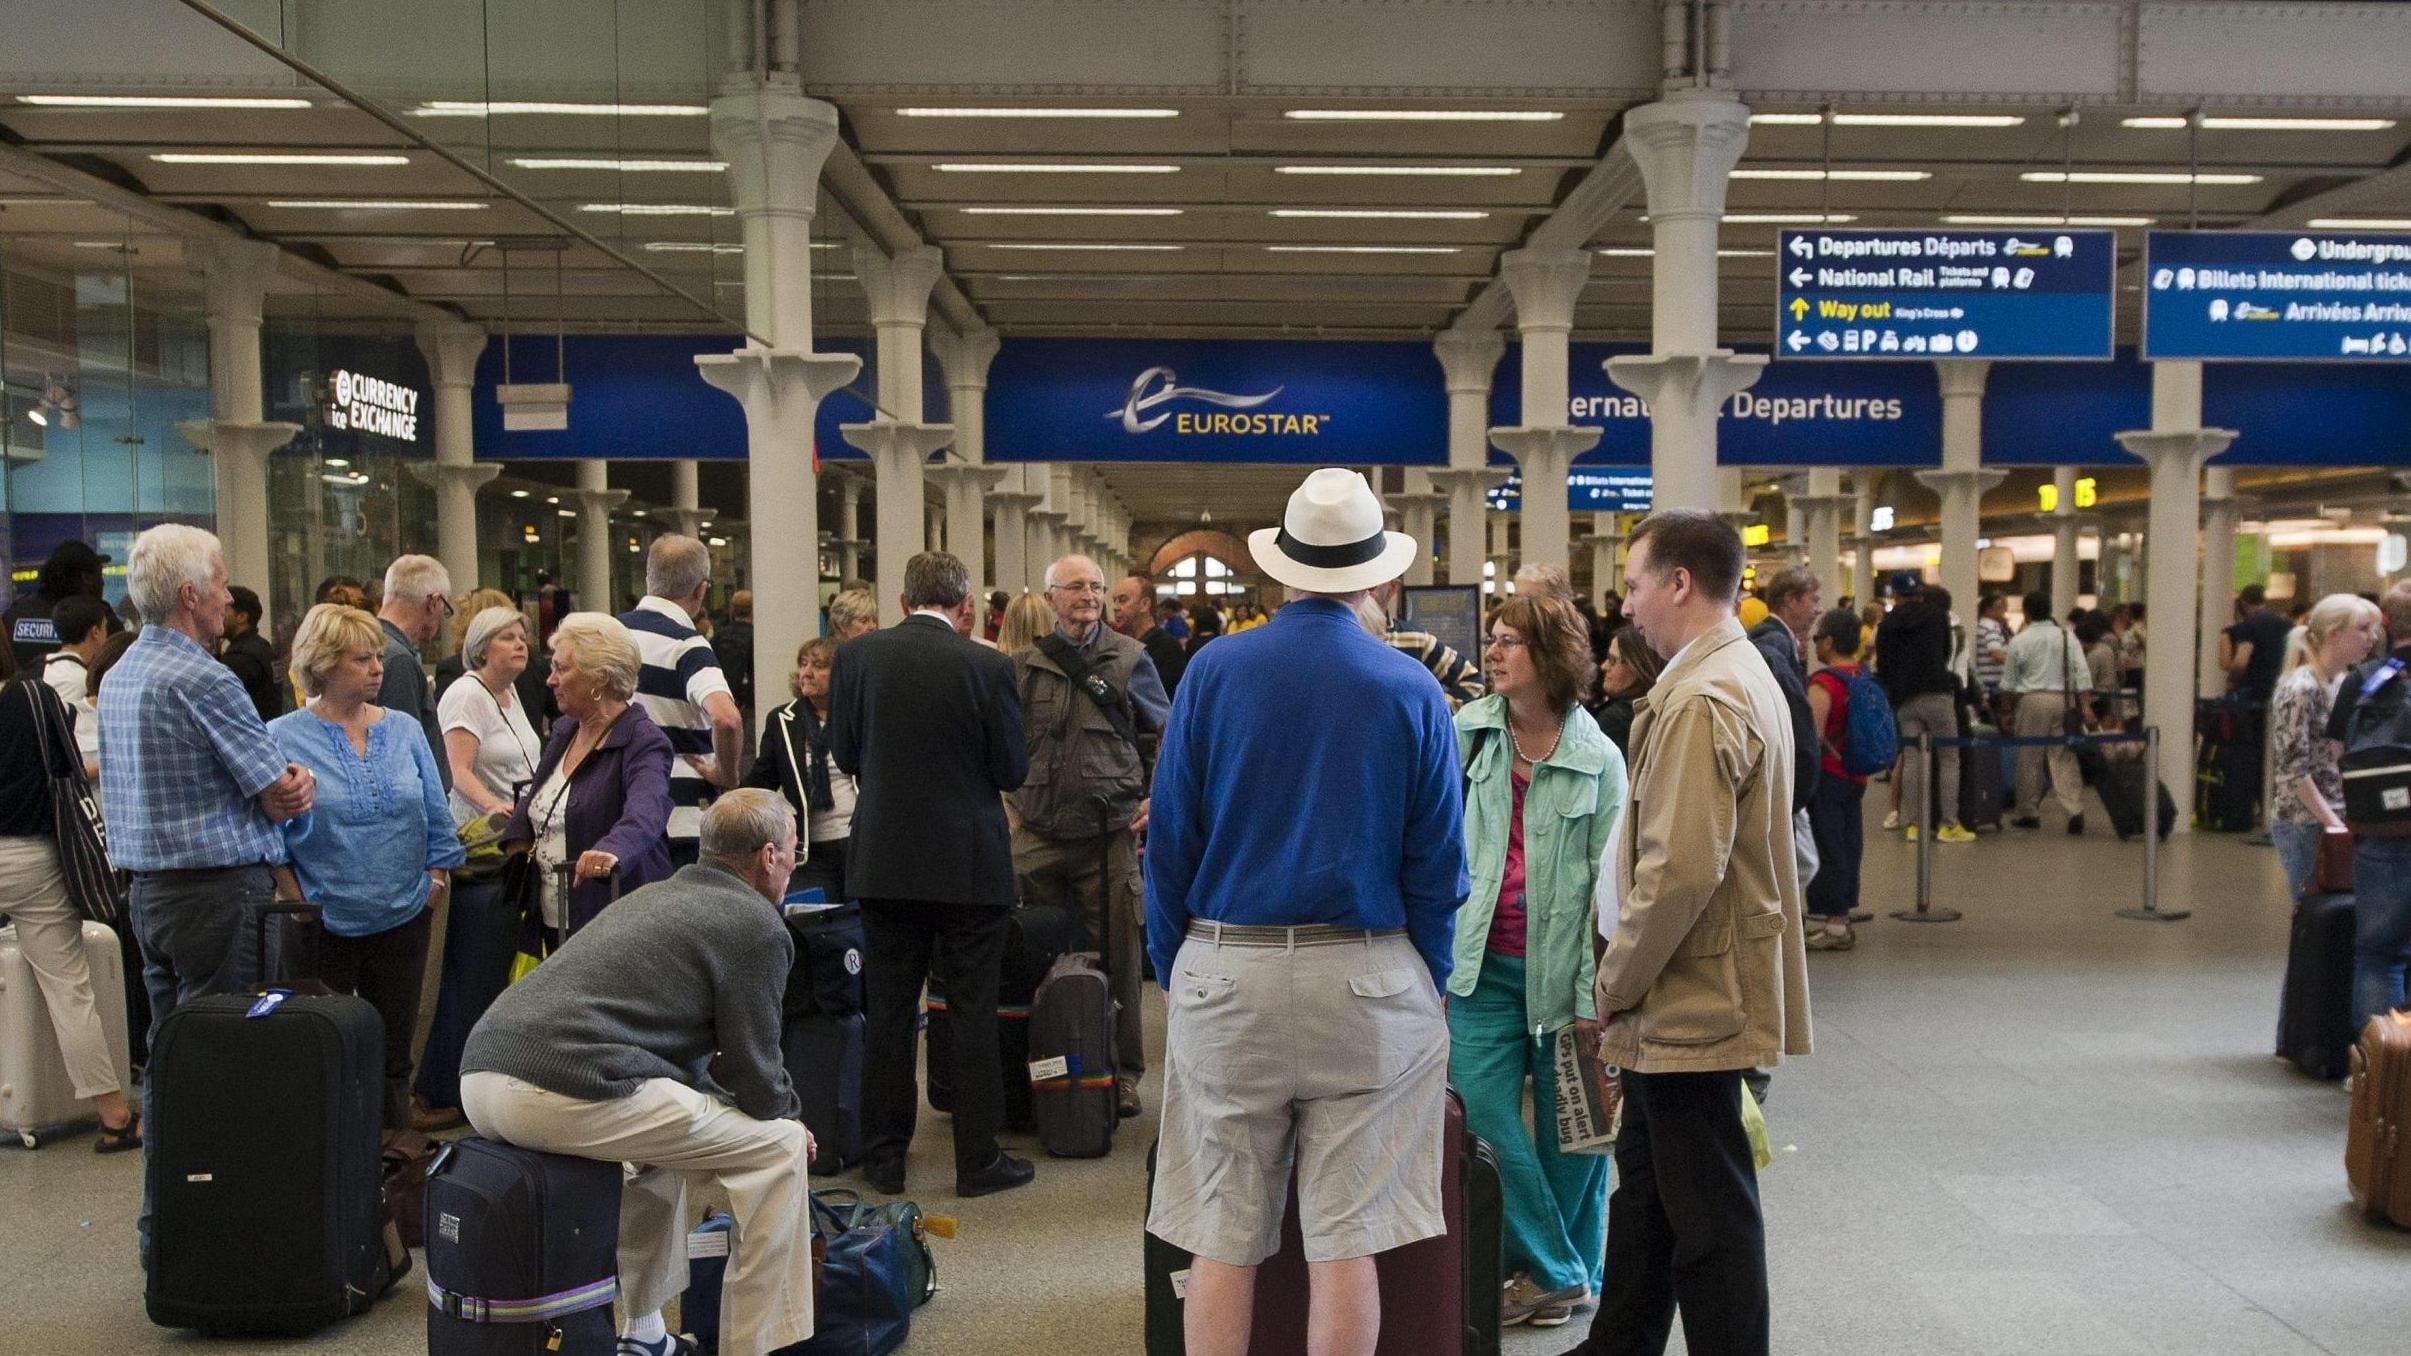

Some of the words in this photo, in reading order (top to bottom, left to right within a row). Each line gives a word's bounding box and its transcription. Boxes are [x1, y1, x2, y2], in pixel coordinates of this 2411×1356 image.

[1819, 237, 1921, 259] Departures
[1924, 236, 1996, 259] Départs
[1818, 268, 1895, 287] National
[1898, 268, 1935, 287] Rail
[1972, 267, 1989, 277] and
[2198, 269, 2256, 290] Billets
[2258, 270, 2373, 290] International
[1819, 301, 1858, 322] Way
[1860, 302, 1891, 319] out
[2284, 301, 2362, 321] Arrivées
[352, 372, 418, 415] CURRENCY
[331, 402, 348, 430] ice
[1733, 391, 1903, 424] Departures
[350, 400, 418, 441] EXCHANGE
[16, 621, 58, 639] SECURI
[847, 953, 860, 970] R
[1560, 1032, 1574, 1058] GPs
[1561, 1060, 1579, 1083] put
[1569, 1085, 1582, 1106] on
[1560, 1117, 1573, 1145] bug
[1574, 1107, 1592, 1141] alert
